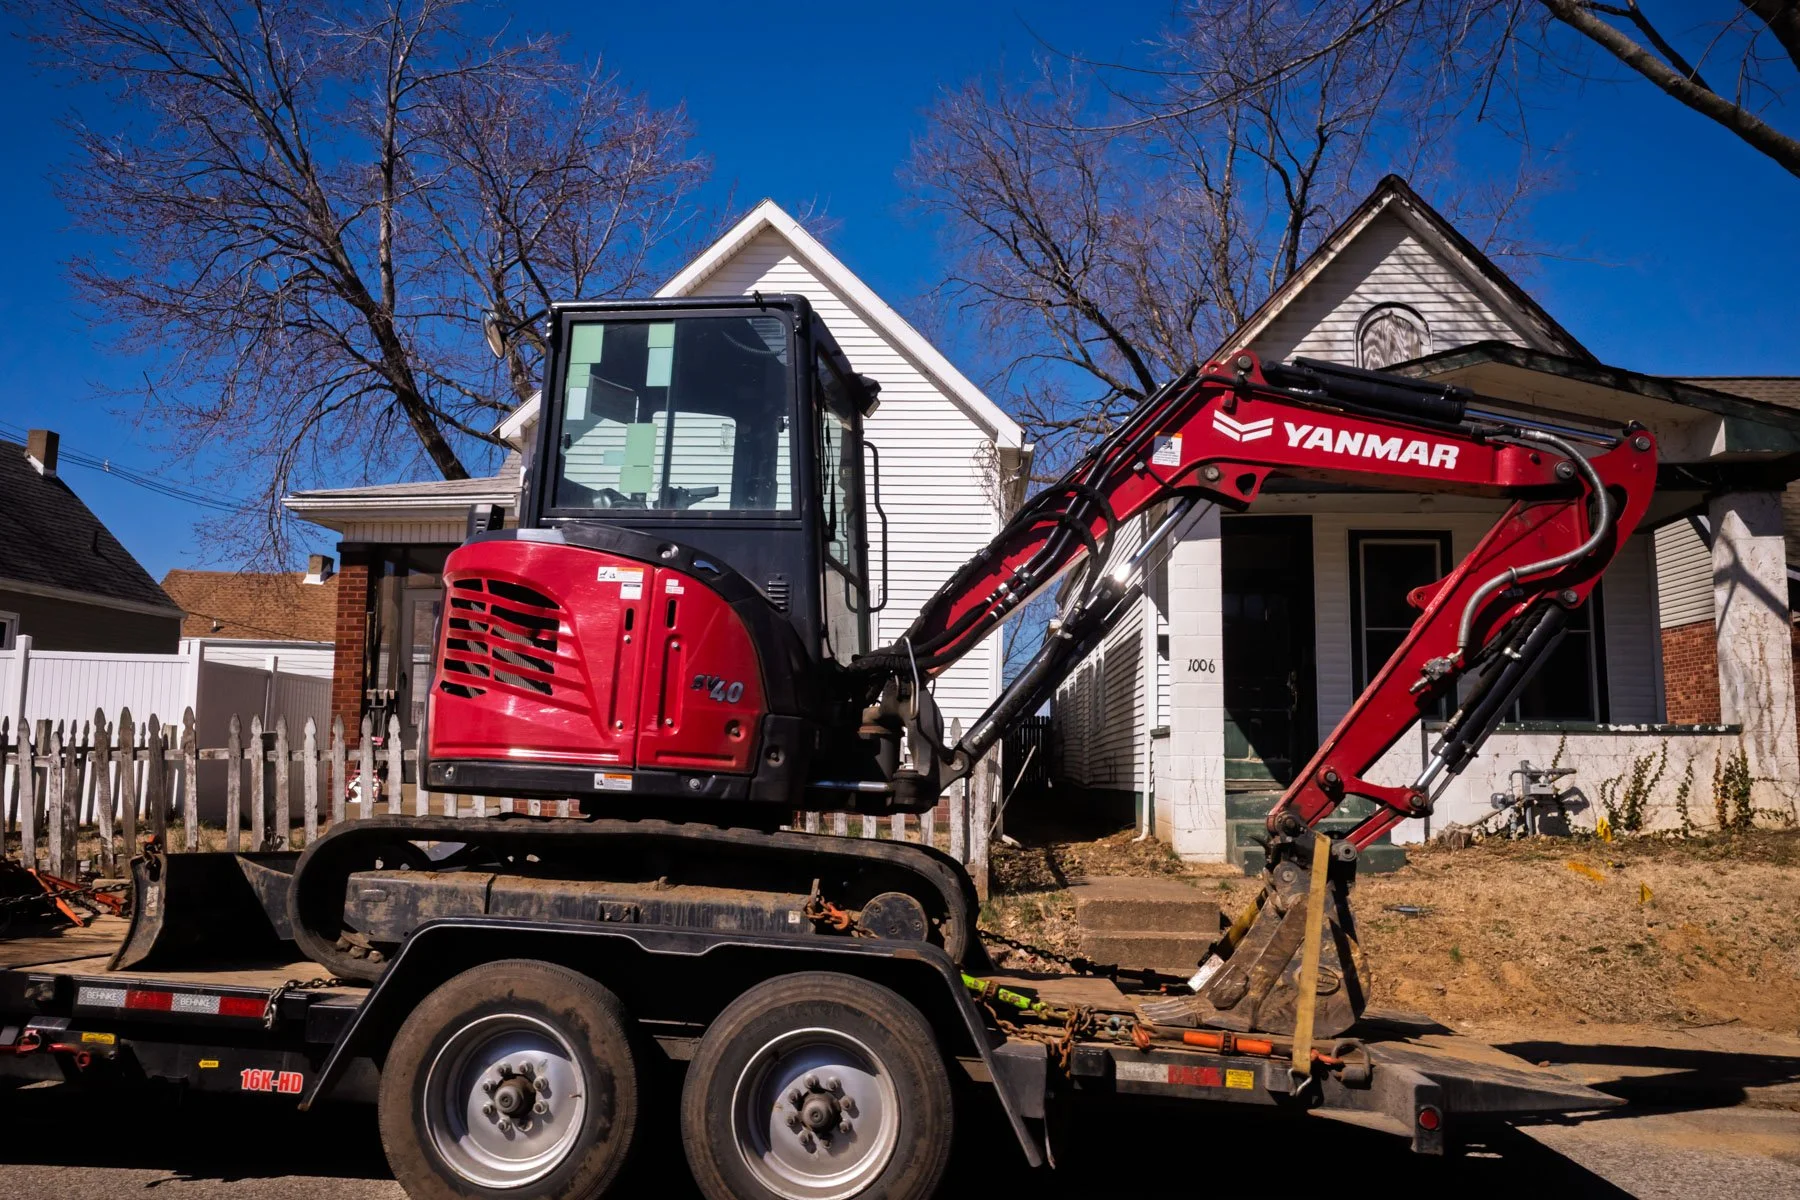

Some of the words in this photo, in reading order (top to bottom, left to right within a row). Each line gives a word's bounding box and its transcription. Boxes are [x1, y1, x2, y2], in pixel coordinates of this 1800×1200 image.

[1284, 422, 1460, 470] YANMAR
[1188, 659, 1216, 673] 1006
[86, 991, 117, 1001] BEHNKE
[180, 997, 210, 1007] BEHNKE
[240, 1068, 304, 1094] 16K-HD
